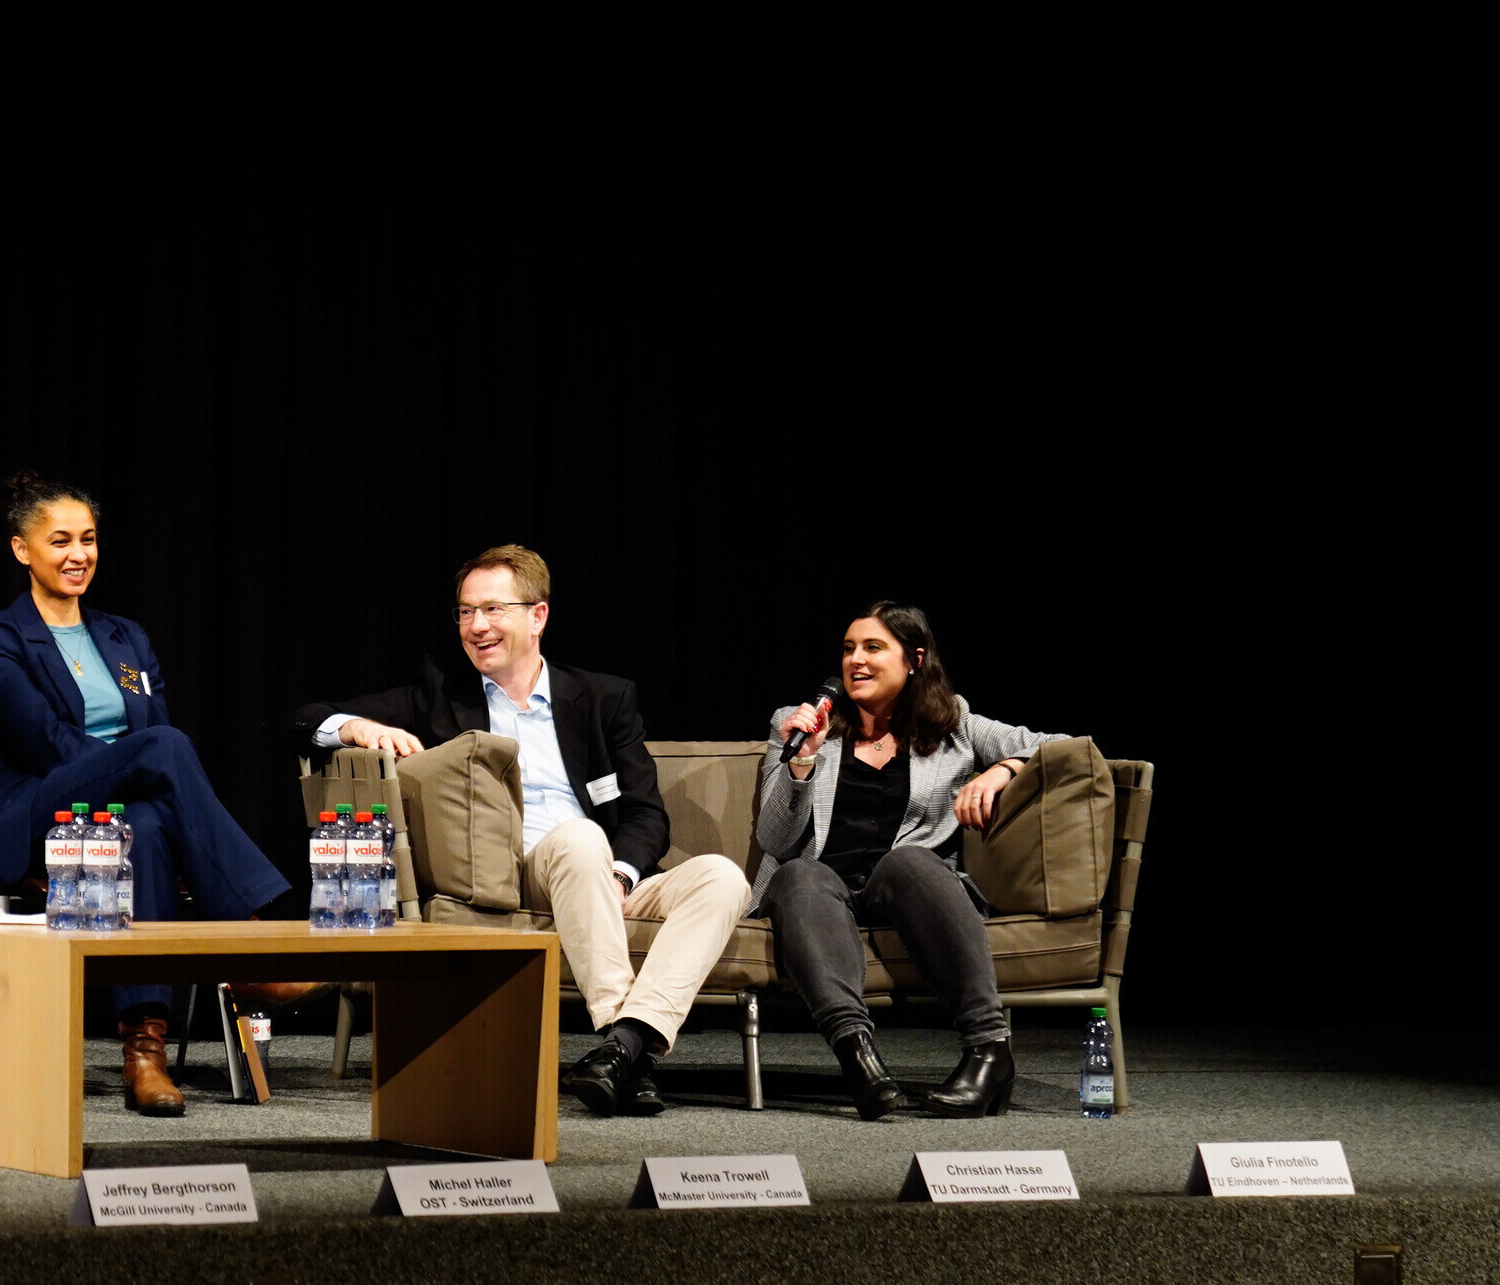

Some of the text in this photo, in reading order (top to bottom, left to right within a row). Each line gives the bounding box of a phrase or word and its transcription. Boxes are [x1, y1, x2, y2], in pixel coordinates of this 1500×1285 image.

[50, 844, 81, 856] valais
[86, 844, 118, 856] valais
[312, 843, 344, 855] valais
[1230, 1156, 1318, 1168] Giulia Finotello
[680, 1170, 770, 1183] Keena Trowell
[946, 1165, 1043, 1176] Christian Hasse
[429, 1176, 512, 1191] Michel Haller
[1211, 1177, 1224, 1187] TU
[1228, 1177, 1279, 1186] Eindhoven
[1290, 1176, 1348, 1186] Netherlands
[102, 1182, 236, 1198] Jeffrey Bergthorson
[658, 1192, 705, 1201] McMaster
[708, 1191, 756, 1201] University
[766, 1190, 802, 1198] Canada
[931, 1185, 947, 1195] TU
[950, 1184, 1010, 1194] Darmstadt
[1020, 1184, 1072, 1195] Germany
[420, 1198, 446, 1209] OST
[459, 1194, 534, 1208] Switzerland
[100, 1205, 135, 1216] McGill
[138, 1204, 195, 1216] University
[205, 1202, 247, 1212] Canada
